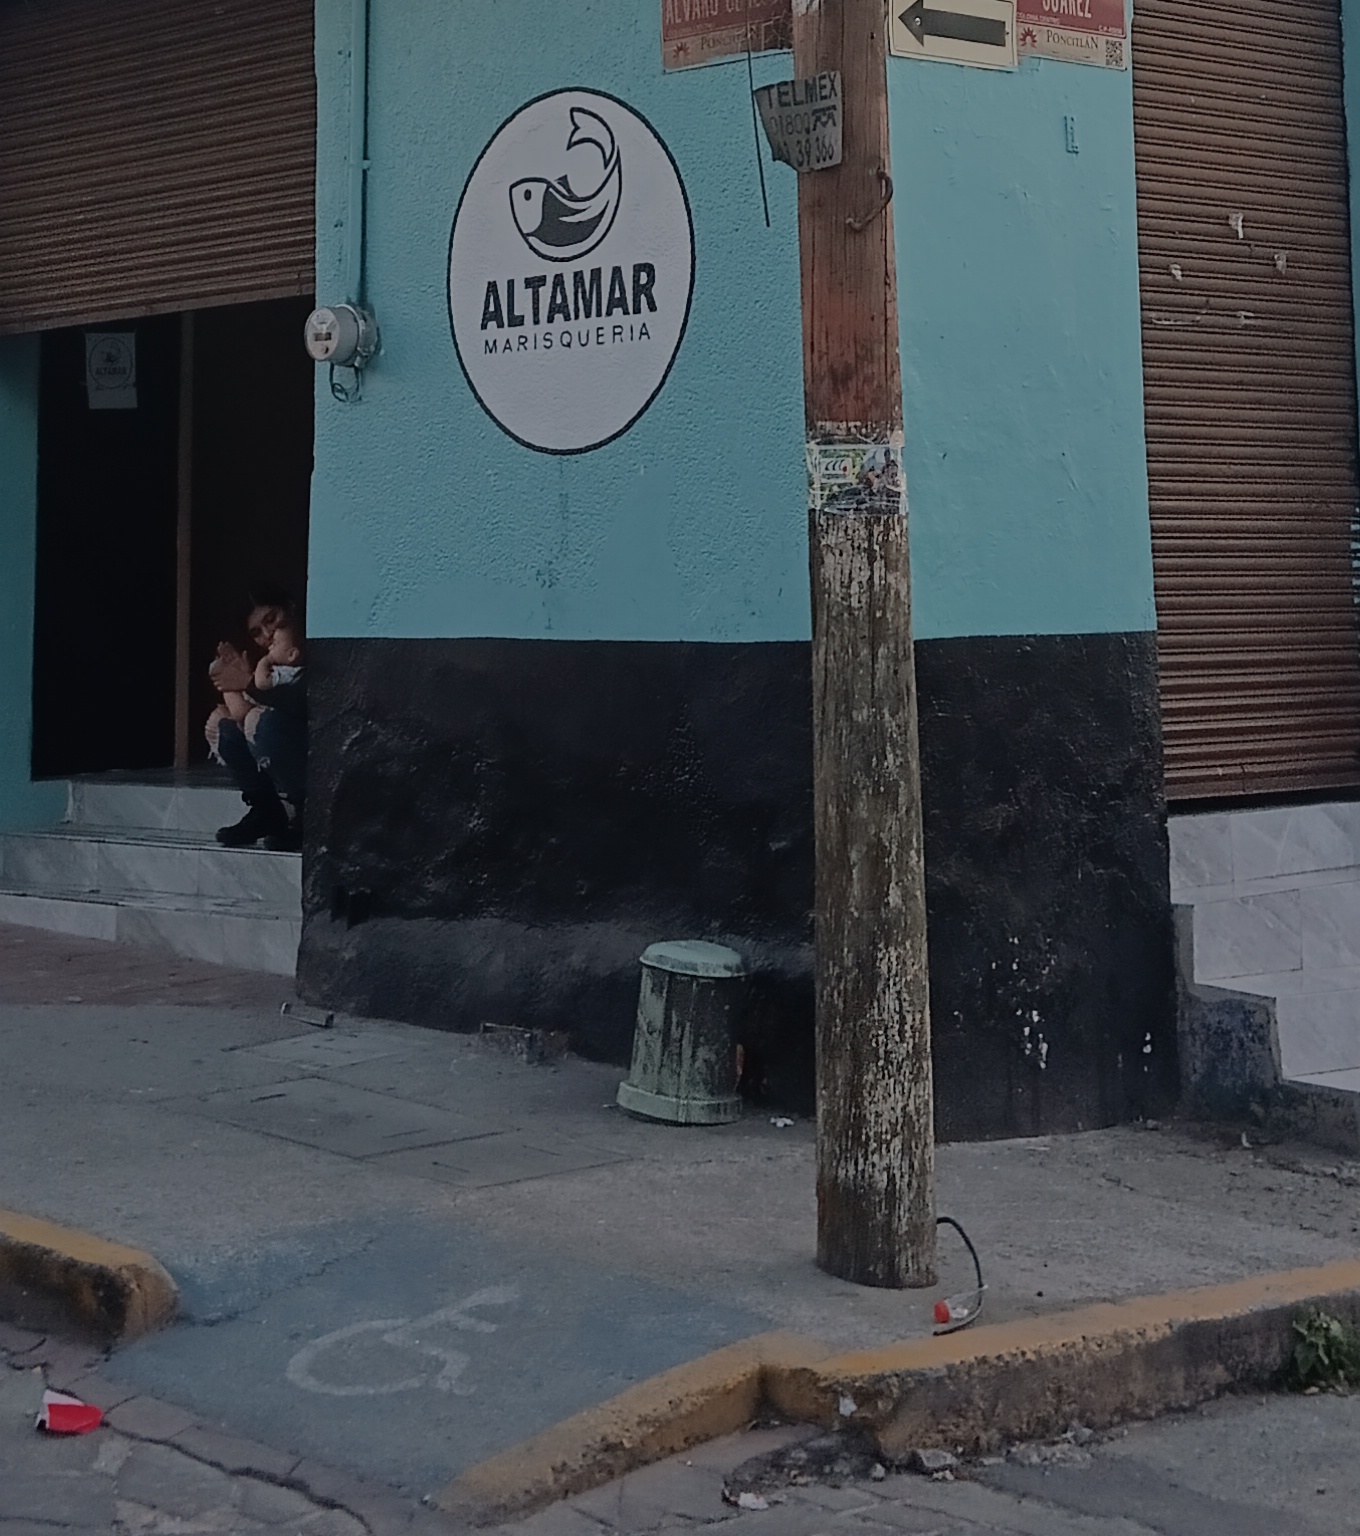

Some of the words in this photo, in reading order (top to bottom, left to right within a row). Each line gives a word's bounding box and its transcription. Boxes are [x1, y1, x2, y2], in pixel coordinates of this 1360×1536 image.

[1046, 29, 1099, 50] PONCITLÁN
[763, 72, 838, 109] TELMEX
[480, 262, 658, 330] ALTAMAR
[483, 321, 652, 355] MARISQUERIA
